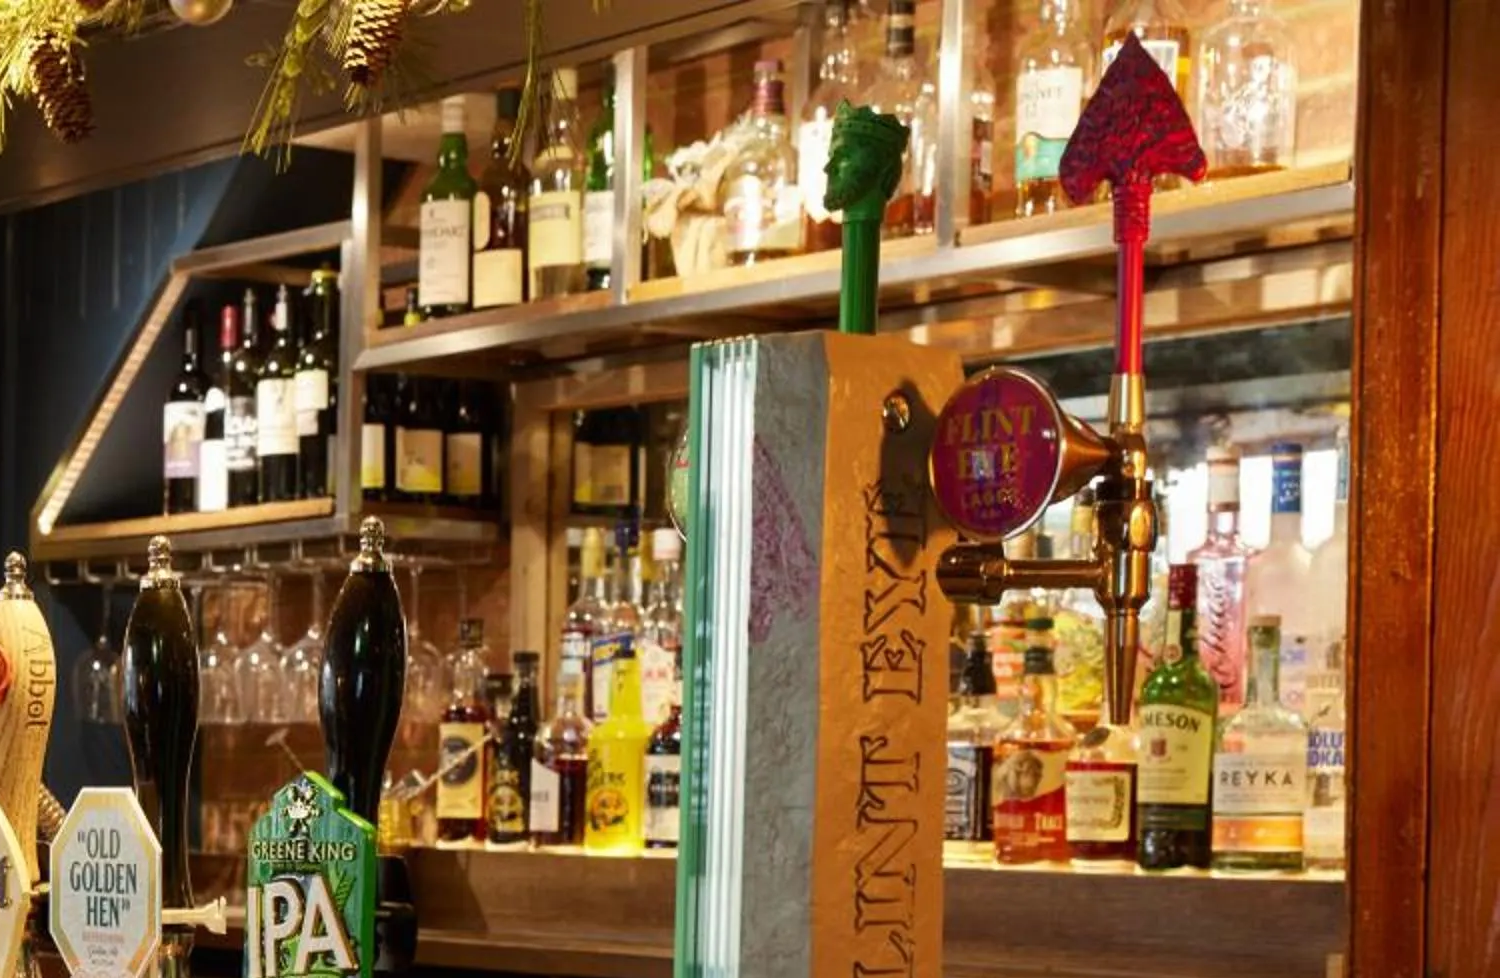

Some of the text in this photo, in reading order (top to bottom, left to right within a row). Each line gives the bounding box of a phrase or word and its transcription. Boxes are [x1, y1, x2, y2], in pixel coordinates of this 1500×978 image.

[21, 624, 54, 730] Abbot
[1220, 769, 1294, 787] REYKA
[252, 840, 357, 863] GREENE KING
[69, 861, 137, 895] GOLDEN
